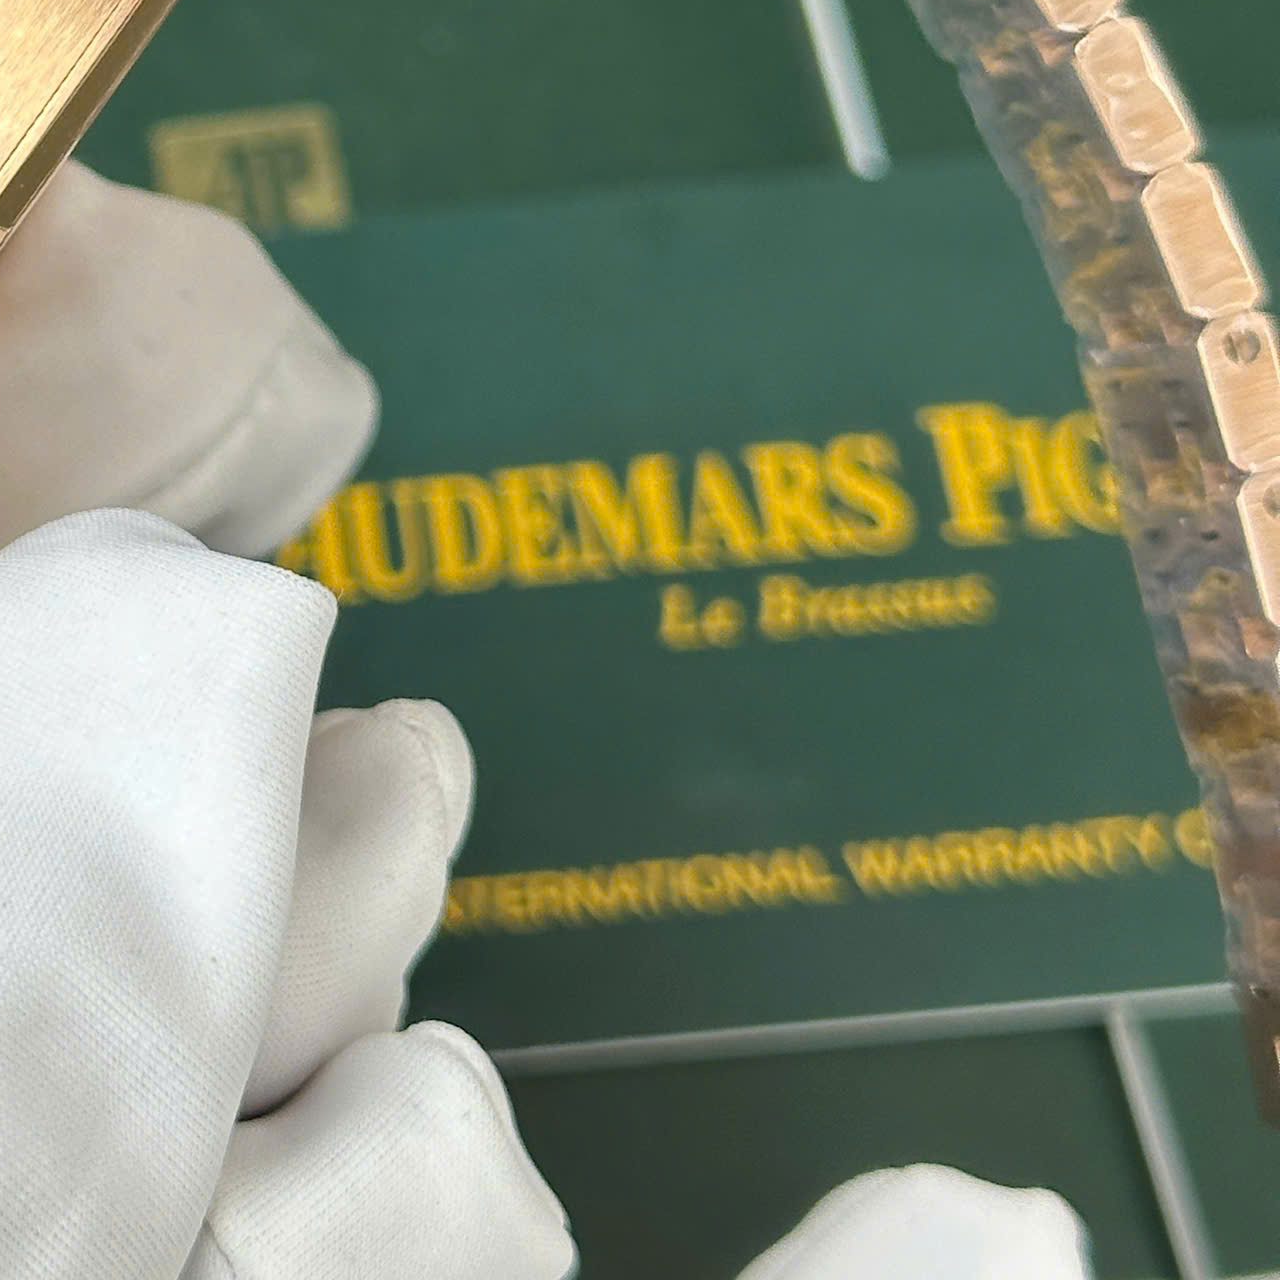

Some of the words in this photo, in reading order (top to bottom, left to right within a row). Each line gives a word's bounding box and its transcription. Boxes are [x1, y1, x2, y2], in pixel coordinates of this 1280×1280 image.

[918, 402, 1124, 548] PIG
[659, 583, 744, 650] Le
[844, 812, 1172, 898] WARRANTY
